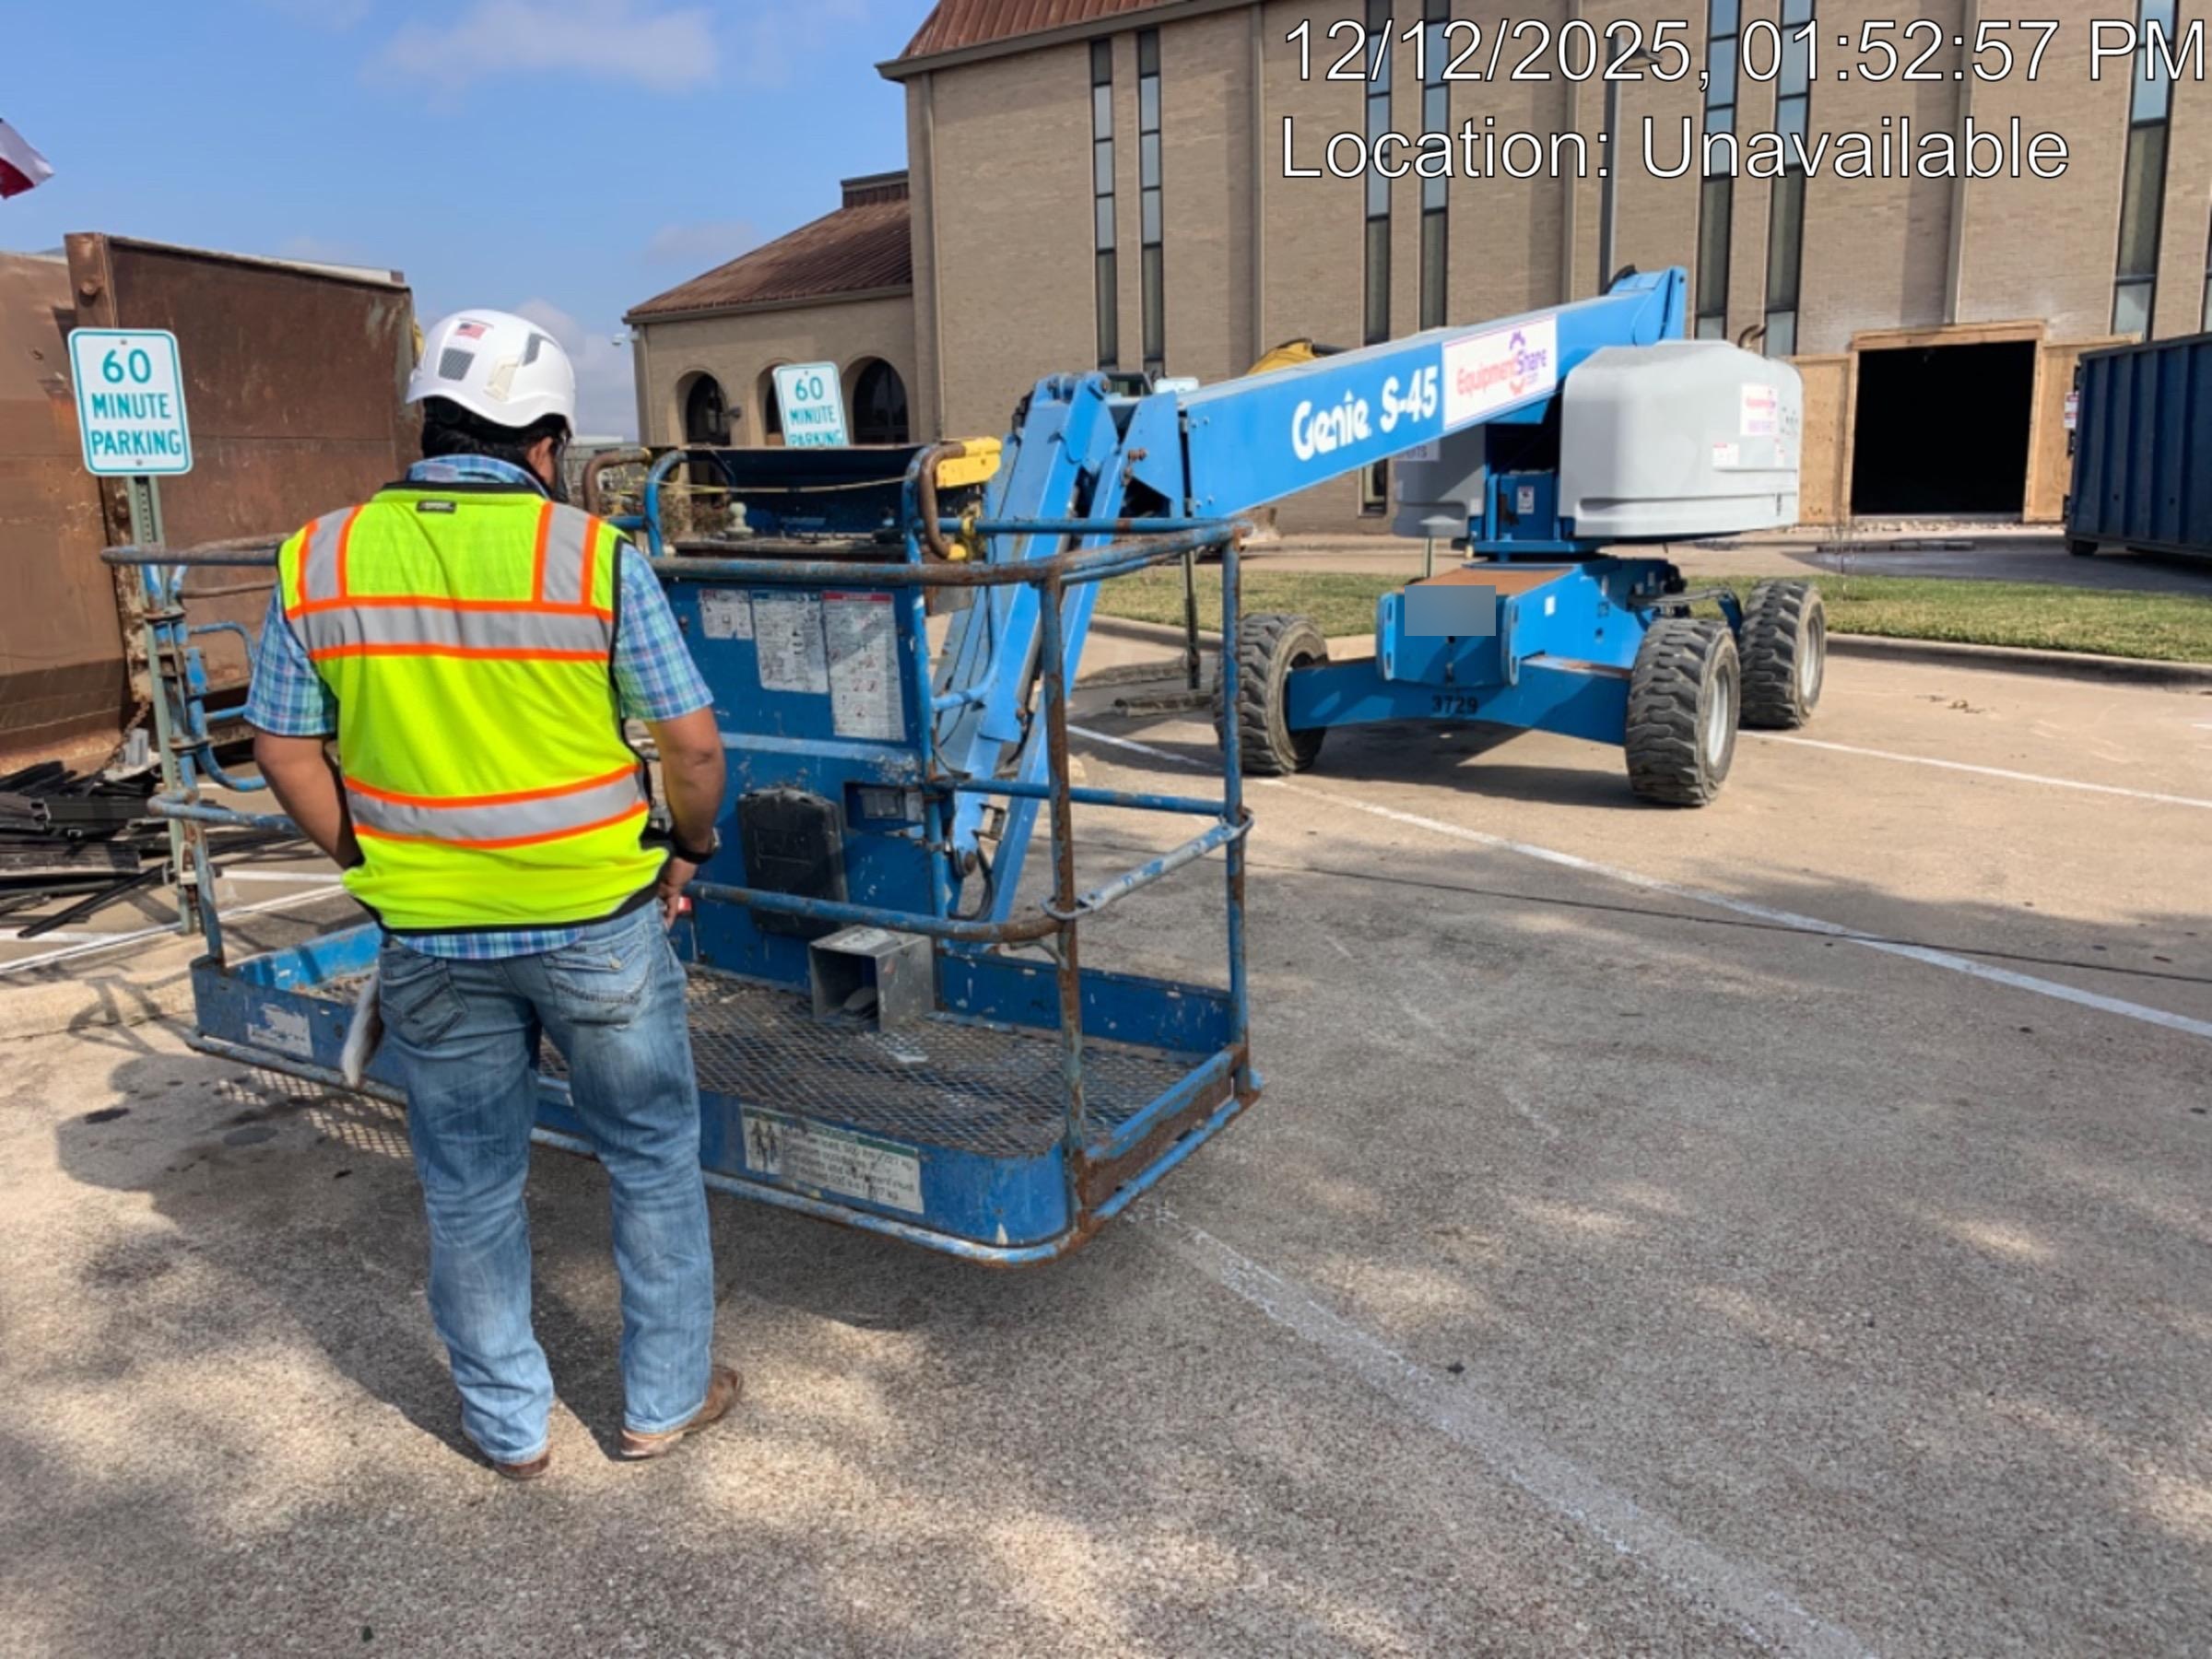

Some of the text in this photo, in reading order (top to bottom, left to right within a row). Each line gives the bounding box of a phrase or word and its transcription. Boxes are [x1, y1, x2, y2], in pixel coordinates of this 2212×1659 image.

[102, 348, 151, 383] 60
[795, 377, 823, 401] 60
[91, 393, 171, 419] MINUTE
[790, 406, 836, 424] MINUTE
[1292, 366, 1438, 461] Genie S-45
[91, 429, 182, 455] PARKING
